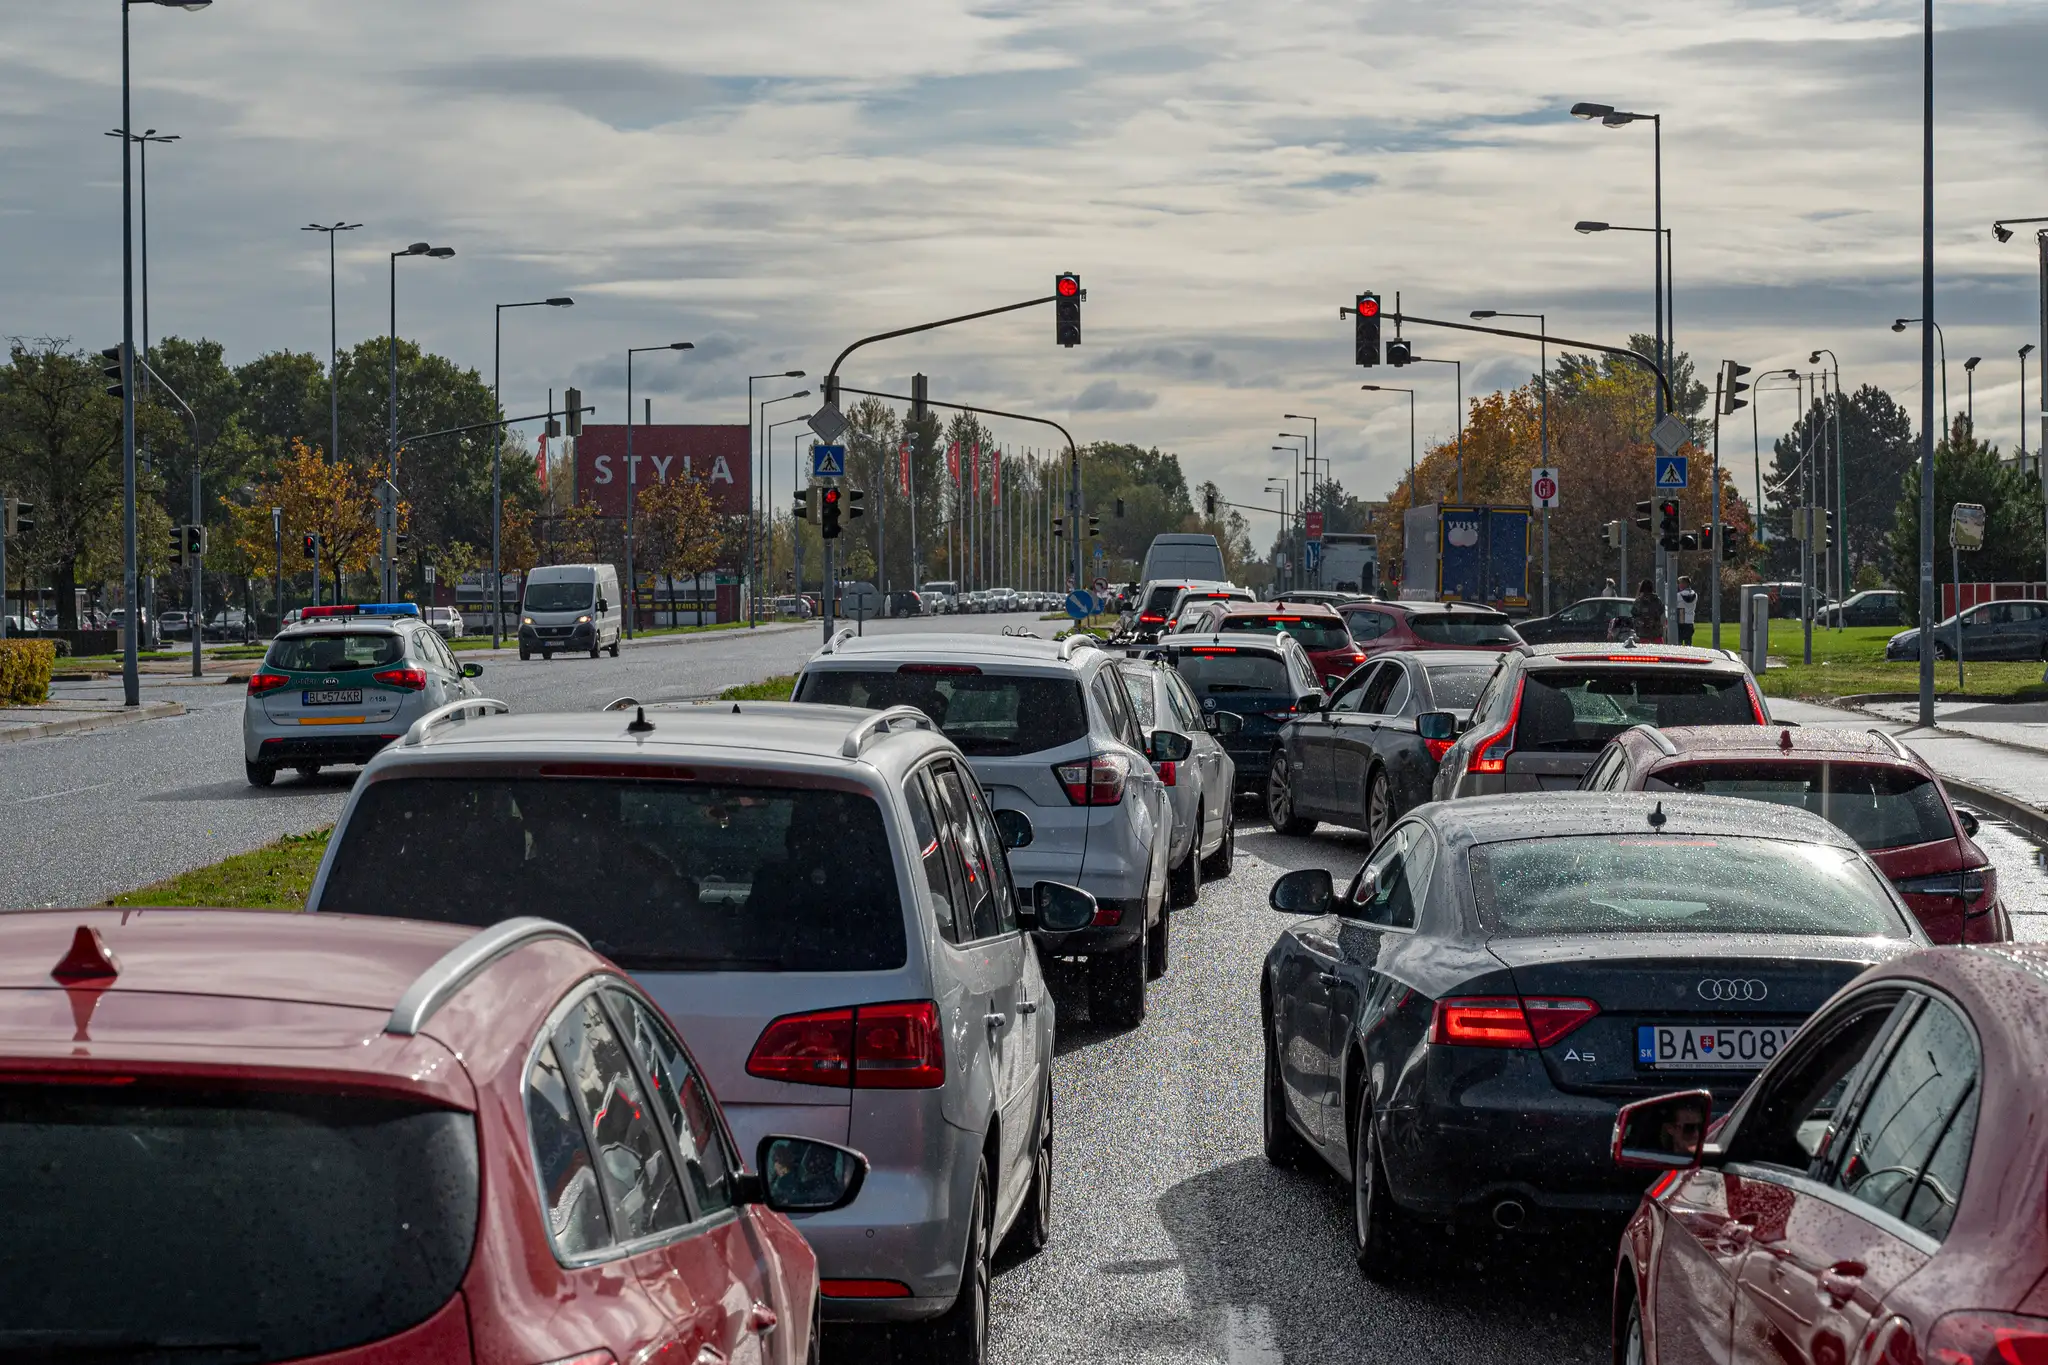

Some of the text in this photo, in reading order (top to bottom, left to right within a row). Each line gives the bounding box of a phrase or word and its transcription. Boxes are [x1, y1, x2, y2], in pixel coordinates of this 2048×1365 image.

[594, 455, 734, 484] STYLA
[309, 690, 360, 704] BL 574KR
[1564, 1048, 1596, 1061] A5
[1640, 1048, 1652, 1058] SK
[1659, 1029, 1698, 1060] BA
